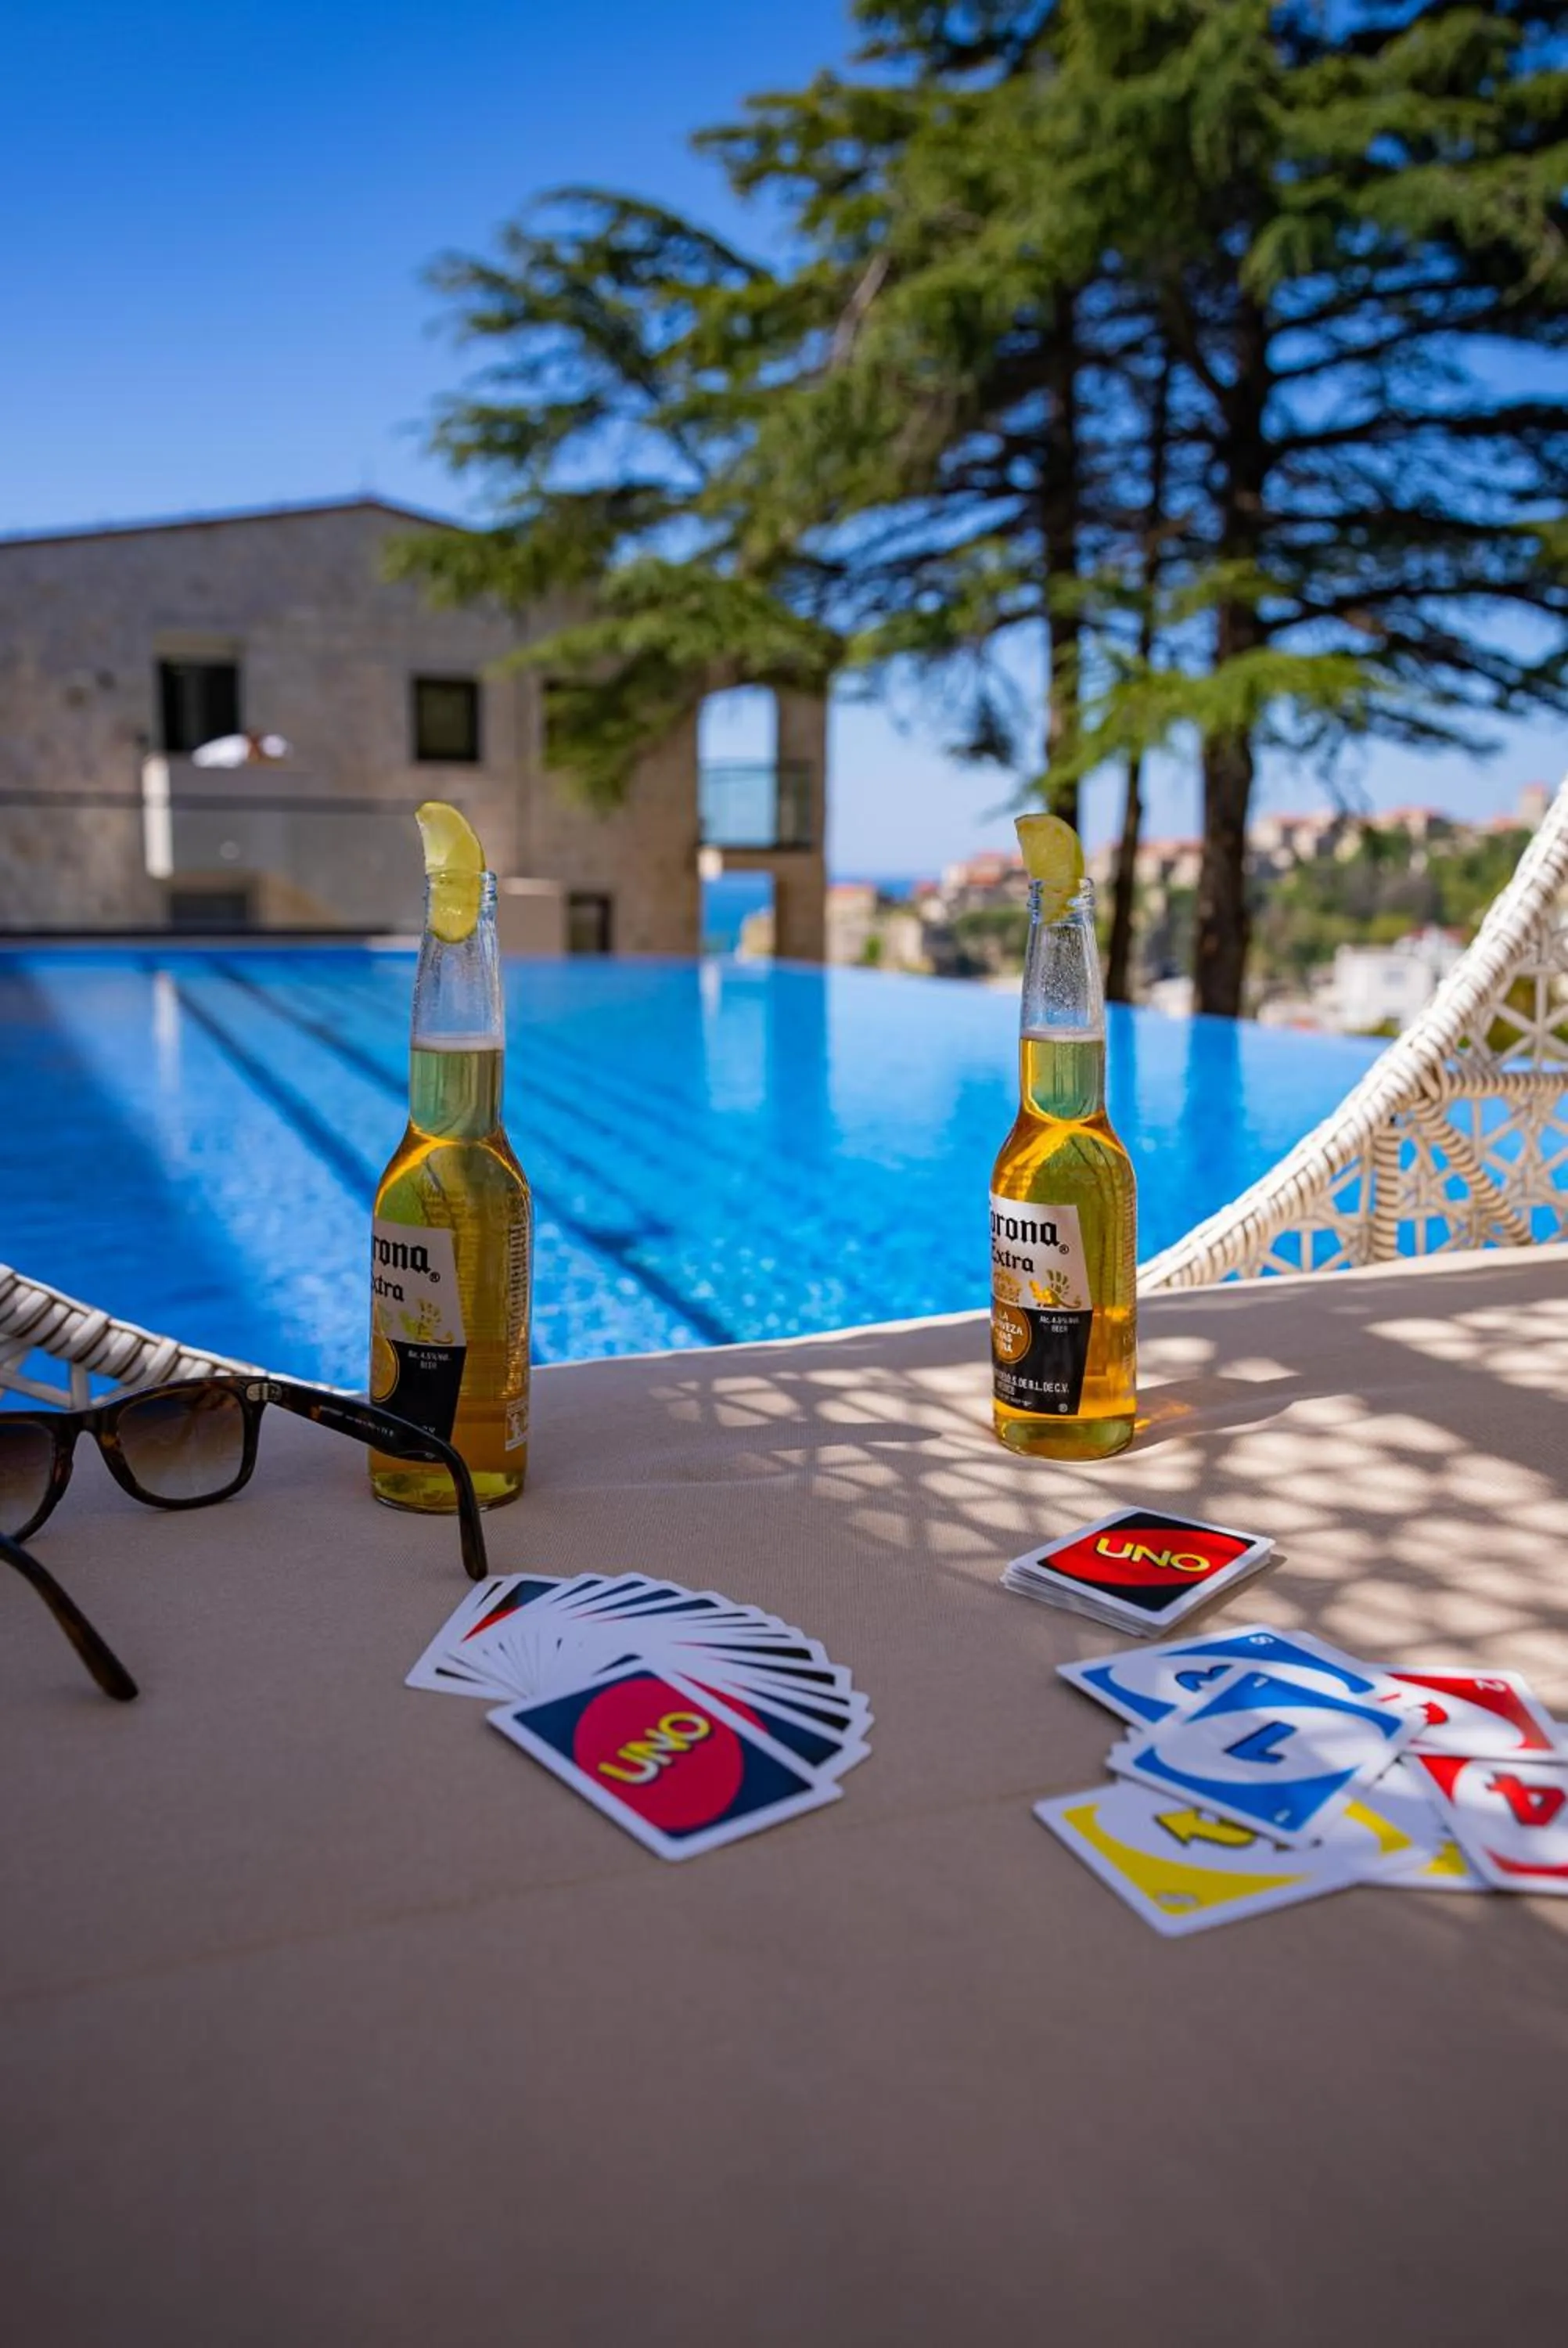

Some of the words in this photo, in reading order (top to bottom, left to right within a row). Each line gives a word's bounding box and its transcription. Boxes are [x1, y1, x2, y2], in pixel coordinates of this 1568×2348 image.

[990, 1210, 1059, 1246] orona
[372, 1235, 431, 1273] rona
[372, 1274, 405, 1302] xtra
[1095, 1536, 1210, 1572] UNO
[598, 1712, 711, 1784] UNO
